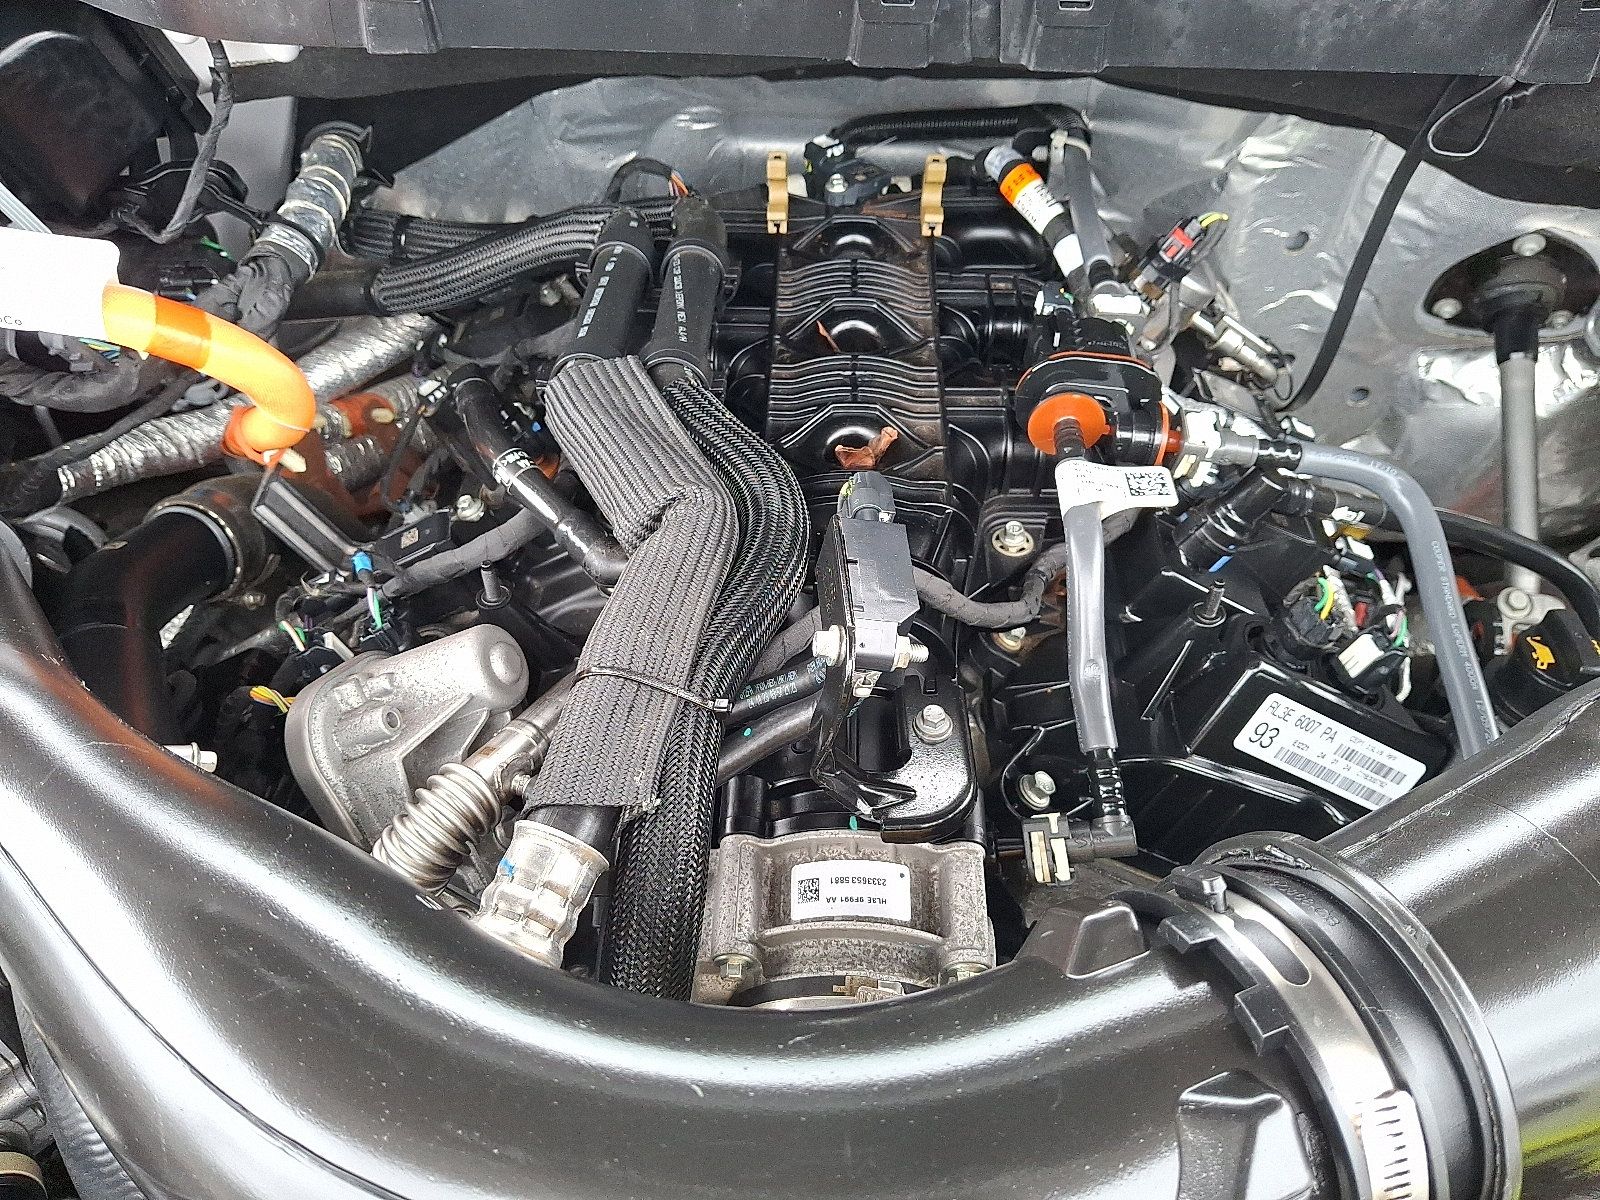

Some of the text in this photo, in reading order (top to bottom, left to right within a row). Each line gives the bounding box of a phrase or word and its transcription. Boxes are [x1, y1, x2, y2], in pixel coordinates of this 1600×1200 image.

[1265, 700, 1338, 743] RL3E 6007 PA
[1248, 722, 1280, 749] 93
[825, 896, 887, 905] HL3E 9F991 AA
